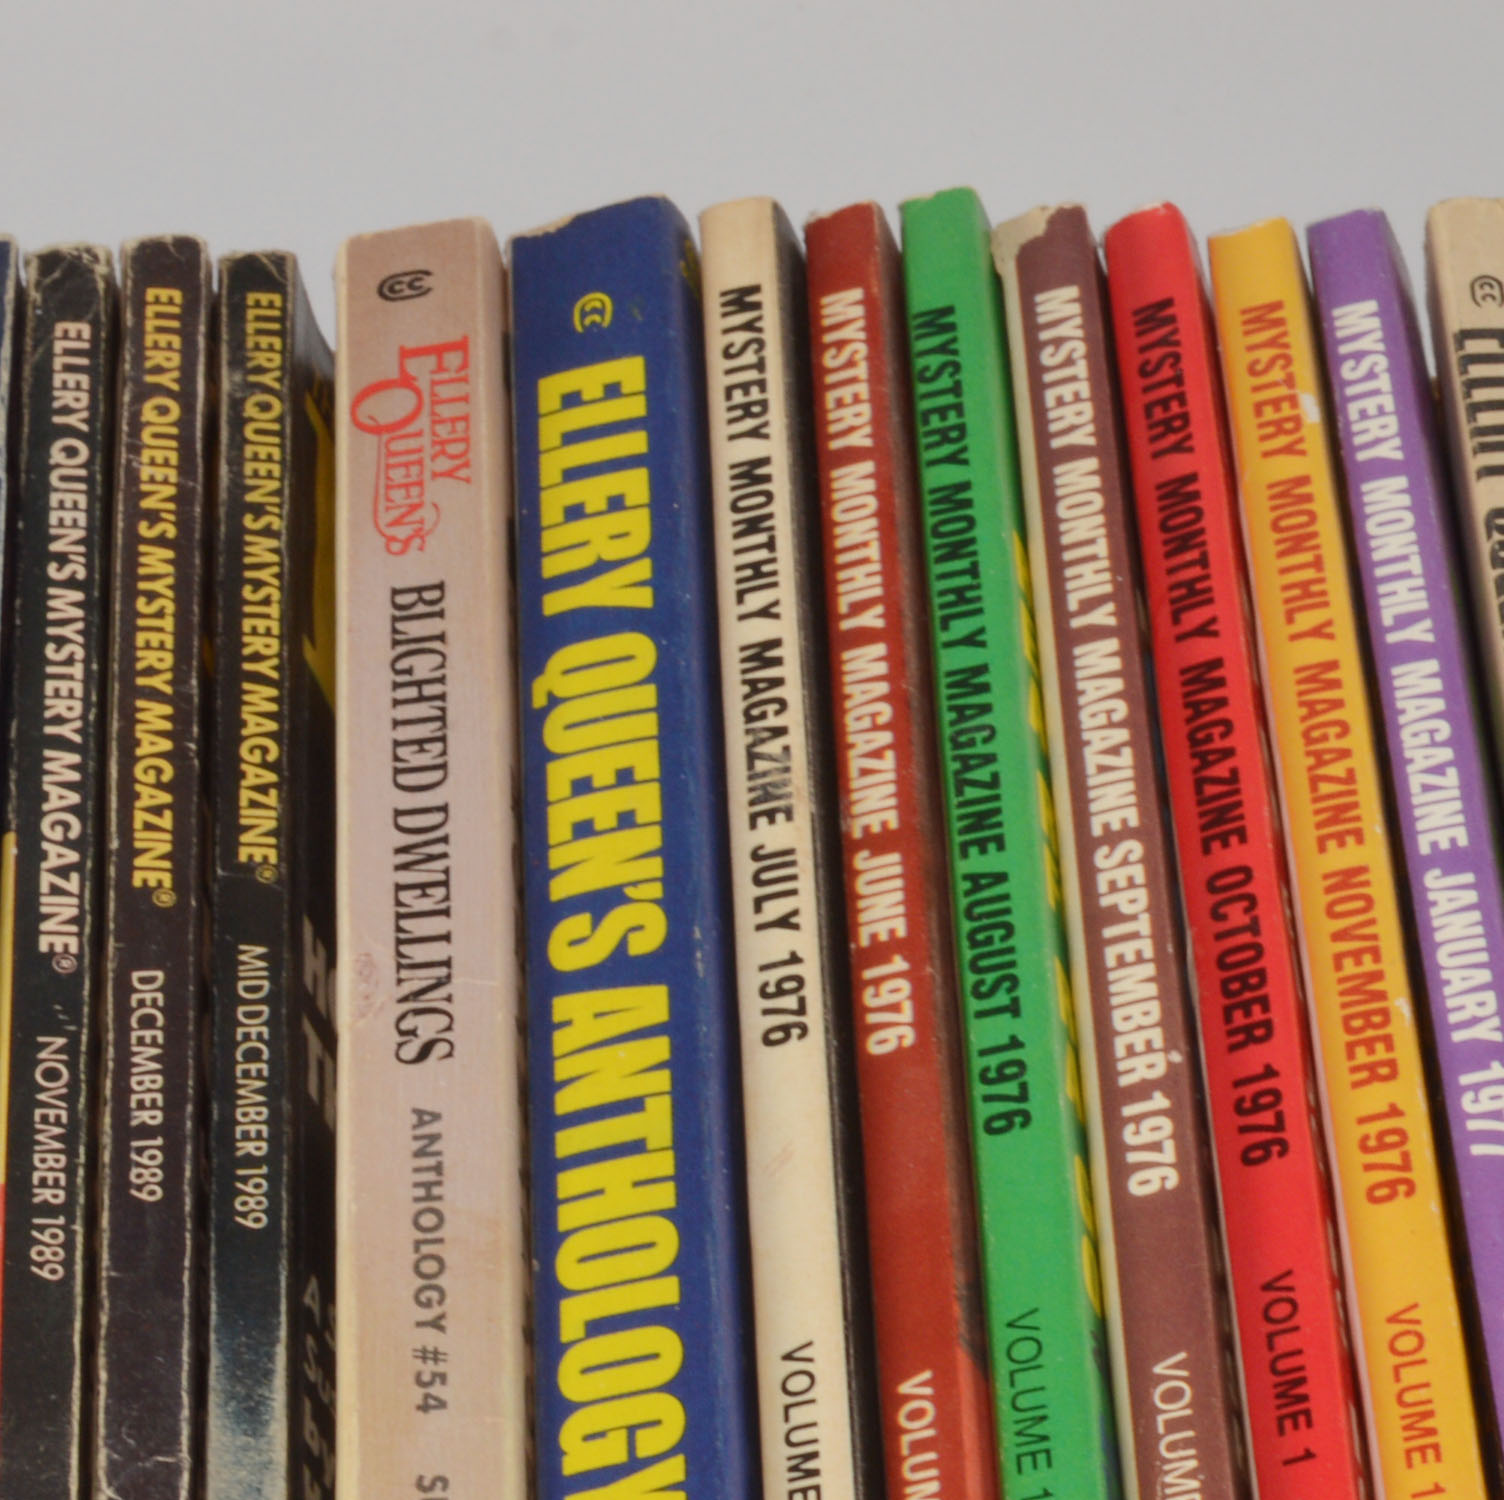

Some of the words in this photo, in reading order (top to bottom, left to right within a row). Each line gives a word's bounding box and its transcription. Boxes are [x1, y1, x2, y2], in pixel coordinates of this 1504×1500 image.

[396, 335, 470, 490] ELLERY
[720, 284, 769, 440] MYSTERY
[1334, 300, 1402, 460] MYSTERY
[349, 372, 428, 554] QUEEN'S
[538, 358, 651, 612] ELLERY
[729, 457, 779, 620] MONTHLY
[1362, 476, 1433, 642] MONTHLY
[390, 582, 447, 792] BLIGHTED
[739, 638, 792, 829] MAGAZINE
[1393, 659, 1467, 853] MAGAZINE
[534, 634, 664, 968] QUEEN'S
[393, 805, 453, 1064] DWELLINGS
[750, 845, 800, 931] JULY
[855, 851, 906, 945] JUNE
[962, 871, 1020, 1018] AUGUST
[1095, 840, 1165, 1084] SEPTEMBER
[1206, 866, 1273, 1052] OCTOBER
[1424, 869, 1501, 1041] JANUARY
[129, 970, 164, 1125] DECEMBER
[237, 944, 270, 999] MID
[758, 951, 808, 1047] 1976
[863, 955, 915, 1054] 1976
[1323, 866, 1397, 1087] NOVEMBER
[32, 1036, 68, 1204] NOVEMBER
[235, 1004, 269, 1156] DECEMBER
[977, 1035, 1031, 1135] 1976
[1122, 1091, 1178, 1195] 1976
[1232, 1064, 1288, 1166] 1976
[1356, 1103, 1416, 1204] 1976
[29, 1215, 65, 1280] 1989
[129, 1136, 163, 1201] 1989
[234, 1165, 268, 1229] 1989
[411, 1108, 446, 1332] ANTHOLOGY
[412, 1345, 447, 1413] #54
[1005, 1308, 1052, 1474] VOLUME
[1260, 1270, 1312, 1436] VOLUME
[1386, 1303, 1441, 1468] VOLUME
